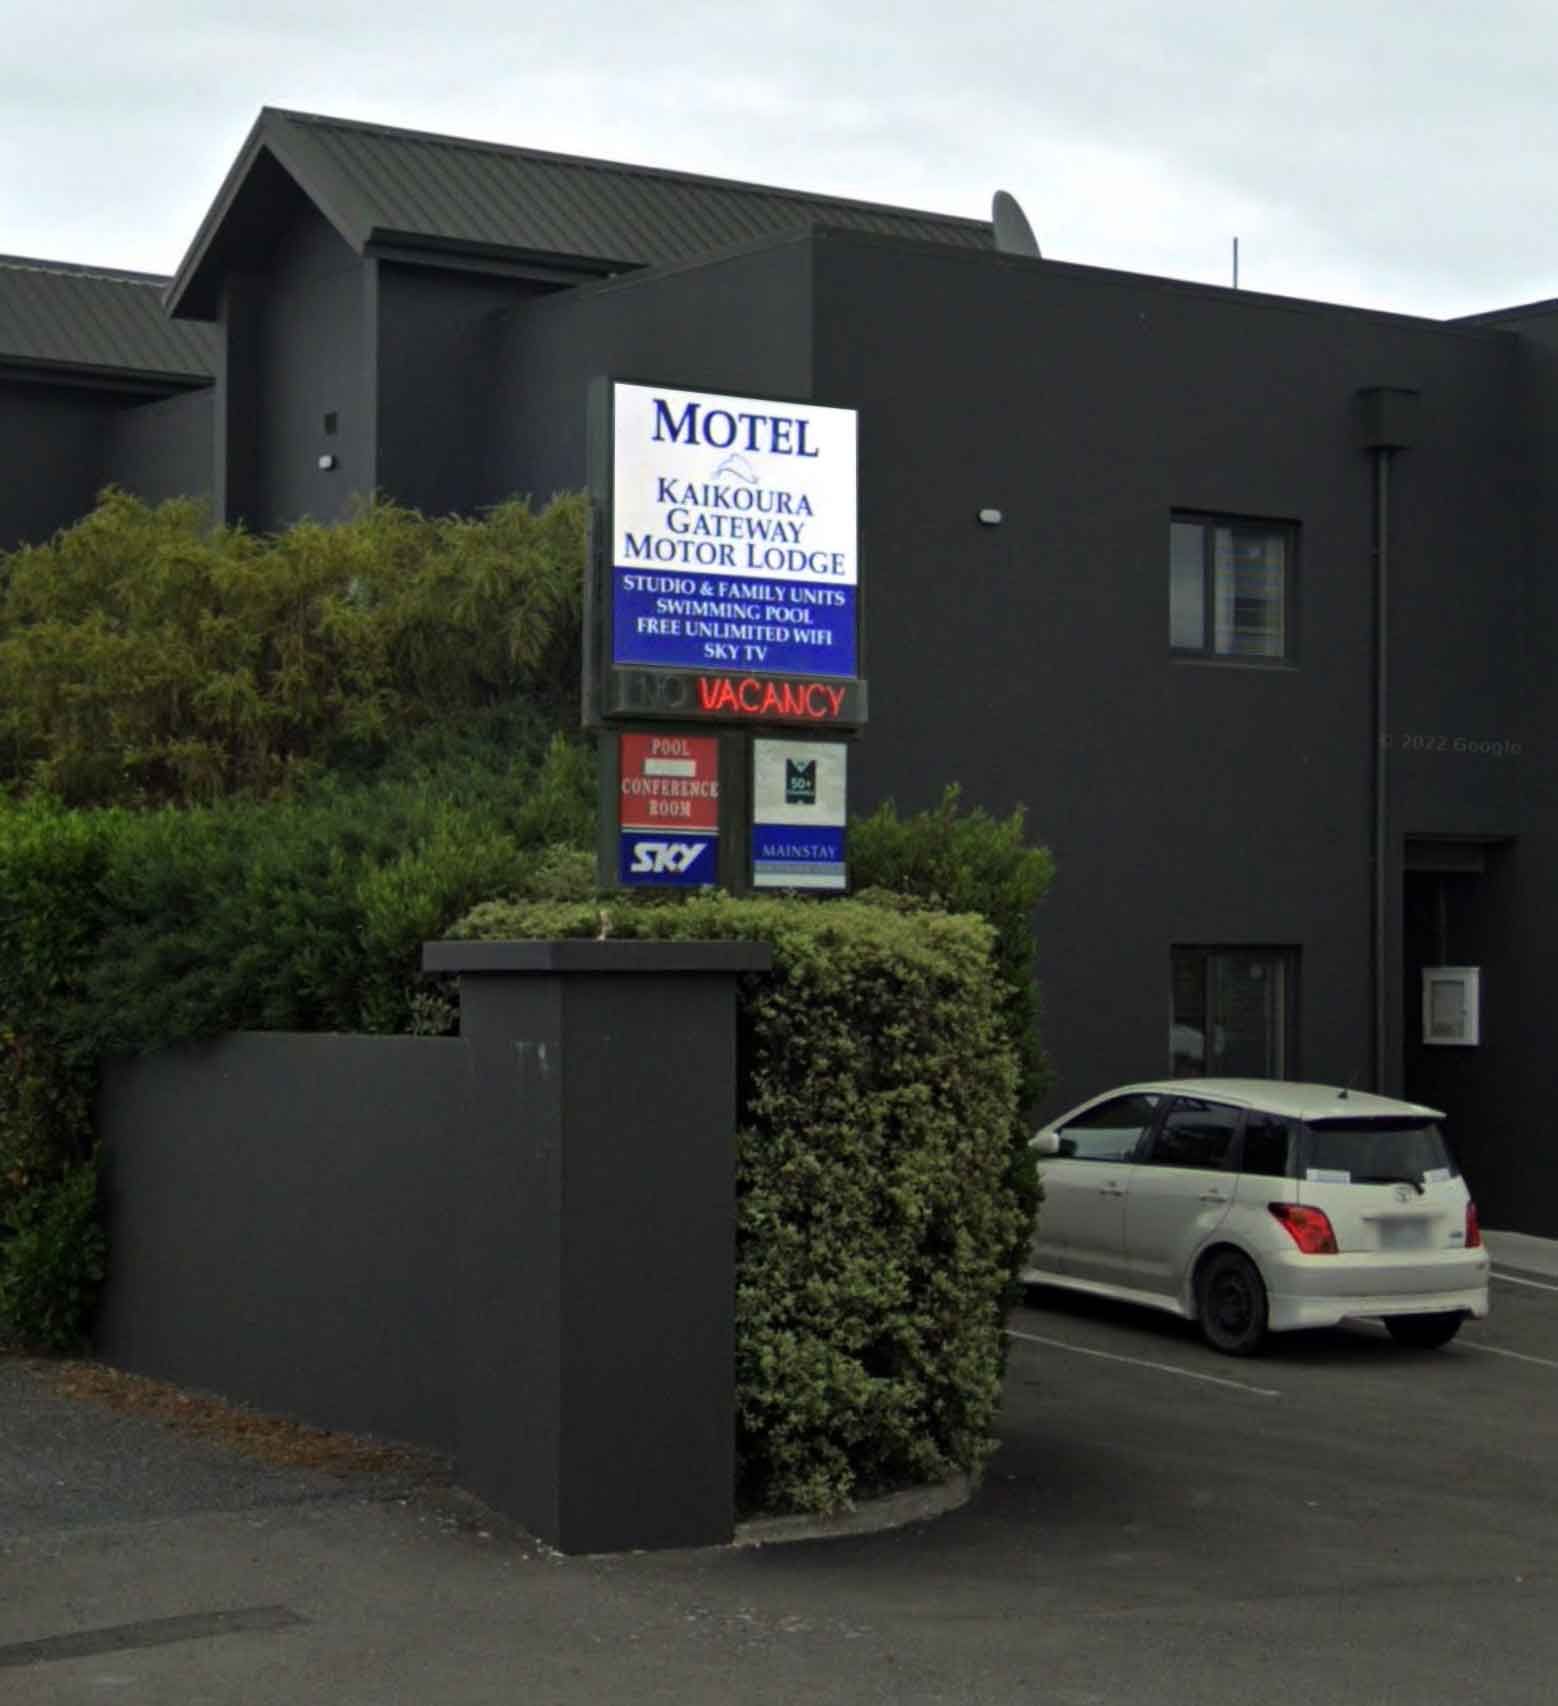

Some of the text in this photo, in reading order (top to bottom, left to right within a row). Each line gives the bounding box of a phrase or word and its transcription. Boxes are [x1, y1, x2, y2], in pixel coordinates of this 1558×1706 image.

[652, 398, 820, 458] MOTEL
[657, 477, 815, 517] KAIKOURA
[666, 508, 805, 545] GATEWAY
[623, 533, 846, 576] MOTOR LODGE
[623, 575, 846, 606] STUDIO & FAMILY UNITS
[656, 599, 814, 625] SWIMMING POOL
[637, 618, 833, 645] FREE UNLIMITED WIFI
[704, 643, 769, 662] SKY TV
[639, 675, 846, 718] NO VACANCY
[651, 738, 690, 756] POOL
[621, 778, 719, 798] CONFERENCE
[648, 801, 692, 817] ROOM
[630, 841, 709, 873] SKY
[761, 844, 837, 859] MAINSTAY
